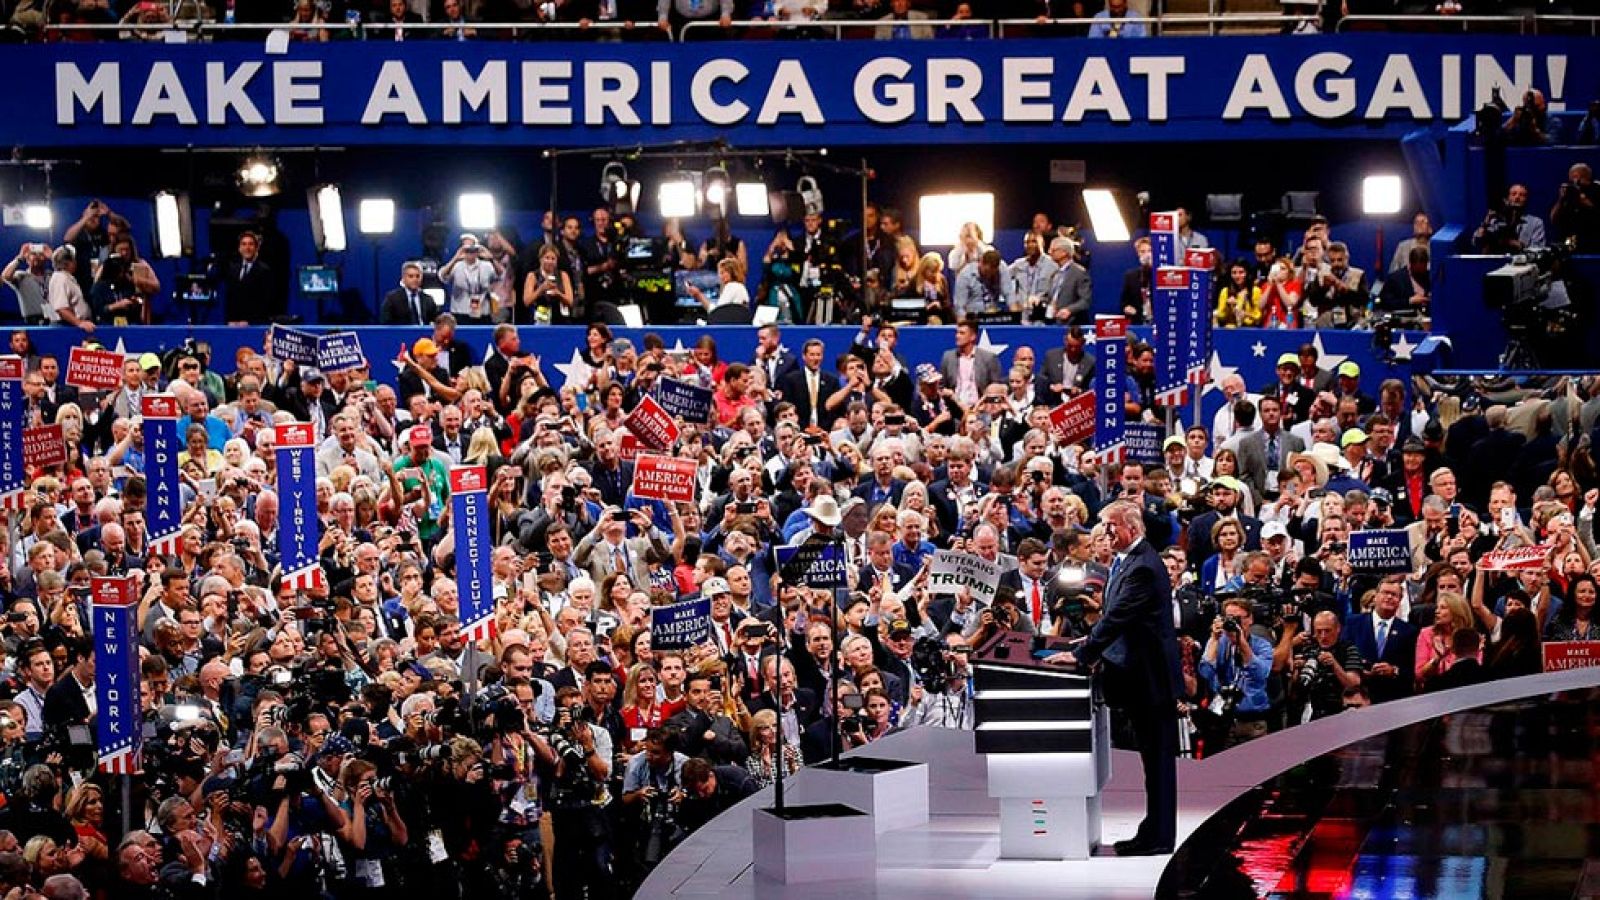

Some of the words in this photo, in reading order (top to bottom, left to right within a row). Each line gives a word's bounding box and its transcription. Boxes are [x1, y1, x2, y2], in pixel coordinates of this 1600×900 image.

[55, 60, 324, 126] MAKE
[361, 58, 825, 126] AMERICA
[853, 55, 1186, 124] GREAT
[1222, 51, 1568, 121] AGAIN!
[1188, 272, 1199, 357] LOUISIANA
[2, 382, 12, 410] NEW
[1104, 343, 1117, 428] OREGON
[2, 421, 12, 481] MEXICO
[154, 425, 170, 520] INDIANA
[290, 449, 302, 483] WEST
[635, 470, 693, 486] AMERICA
[640, 482, 659, 490] SAFE
[662, 485, 688, 493] AGAIN
[293, 491, 305, 558] VIRGINIA
[1366, 536, 1389, 545] MAKE
[466, 494, 481, 610] CONNECTICUT
[1350, 546, 1411, 560] AMERICA
[940, 554, 995, 576] VETERANS
[956, 566, 974, 575] FOR
[1377, 559, 1406, 568] AGAIN
[931, 572, 995, 594] TRUMP
[674, 608, 696, 620] MAKE
[104, 611, 118, 655] NEW
[652, 615, 711, 636] AMERICA
[658, 634, 682, 645] SAFE
[1566, 648, 1590, 656] MAKE
[107, 673, 121, 734] YORK
